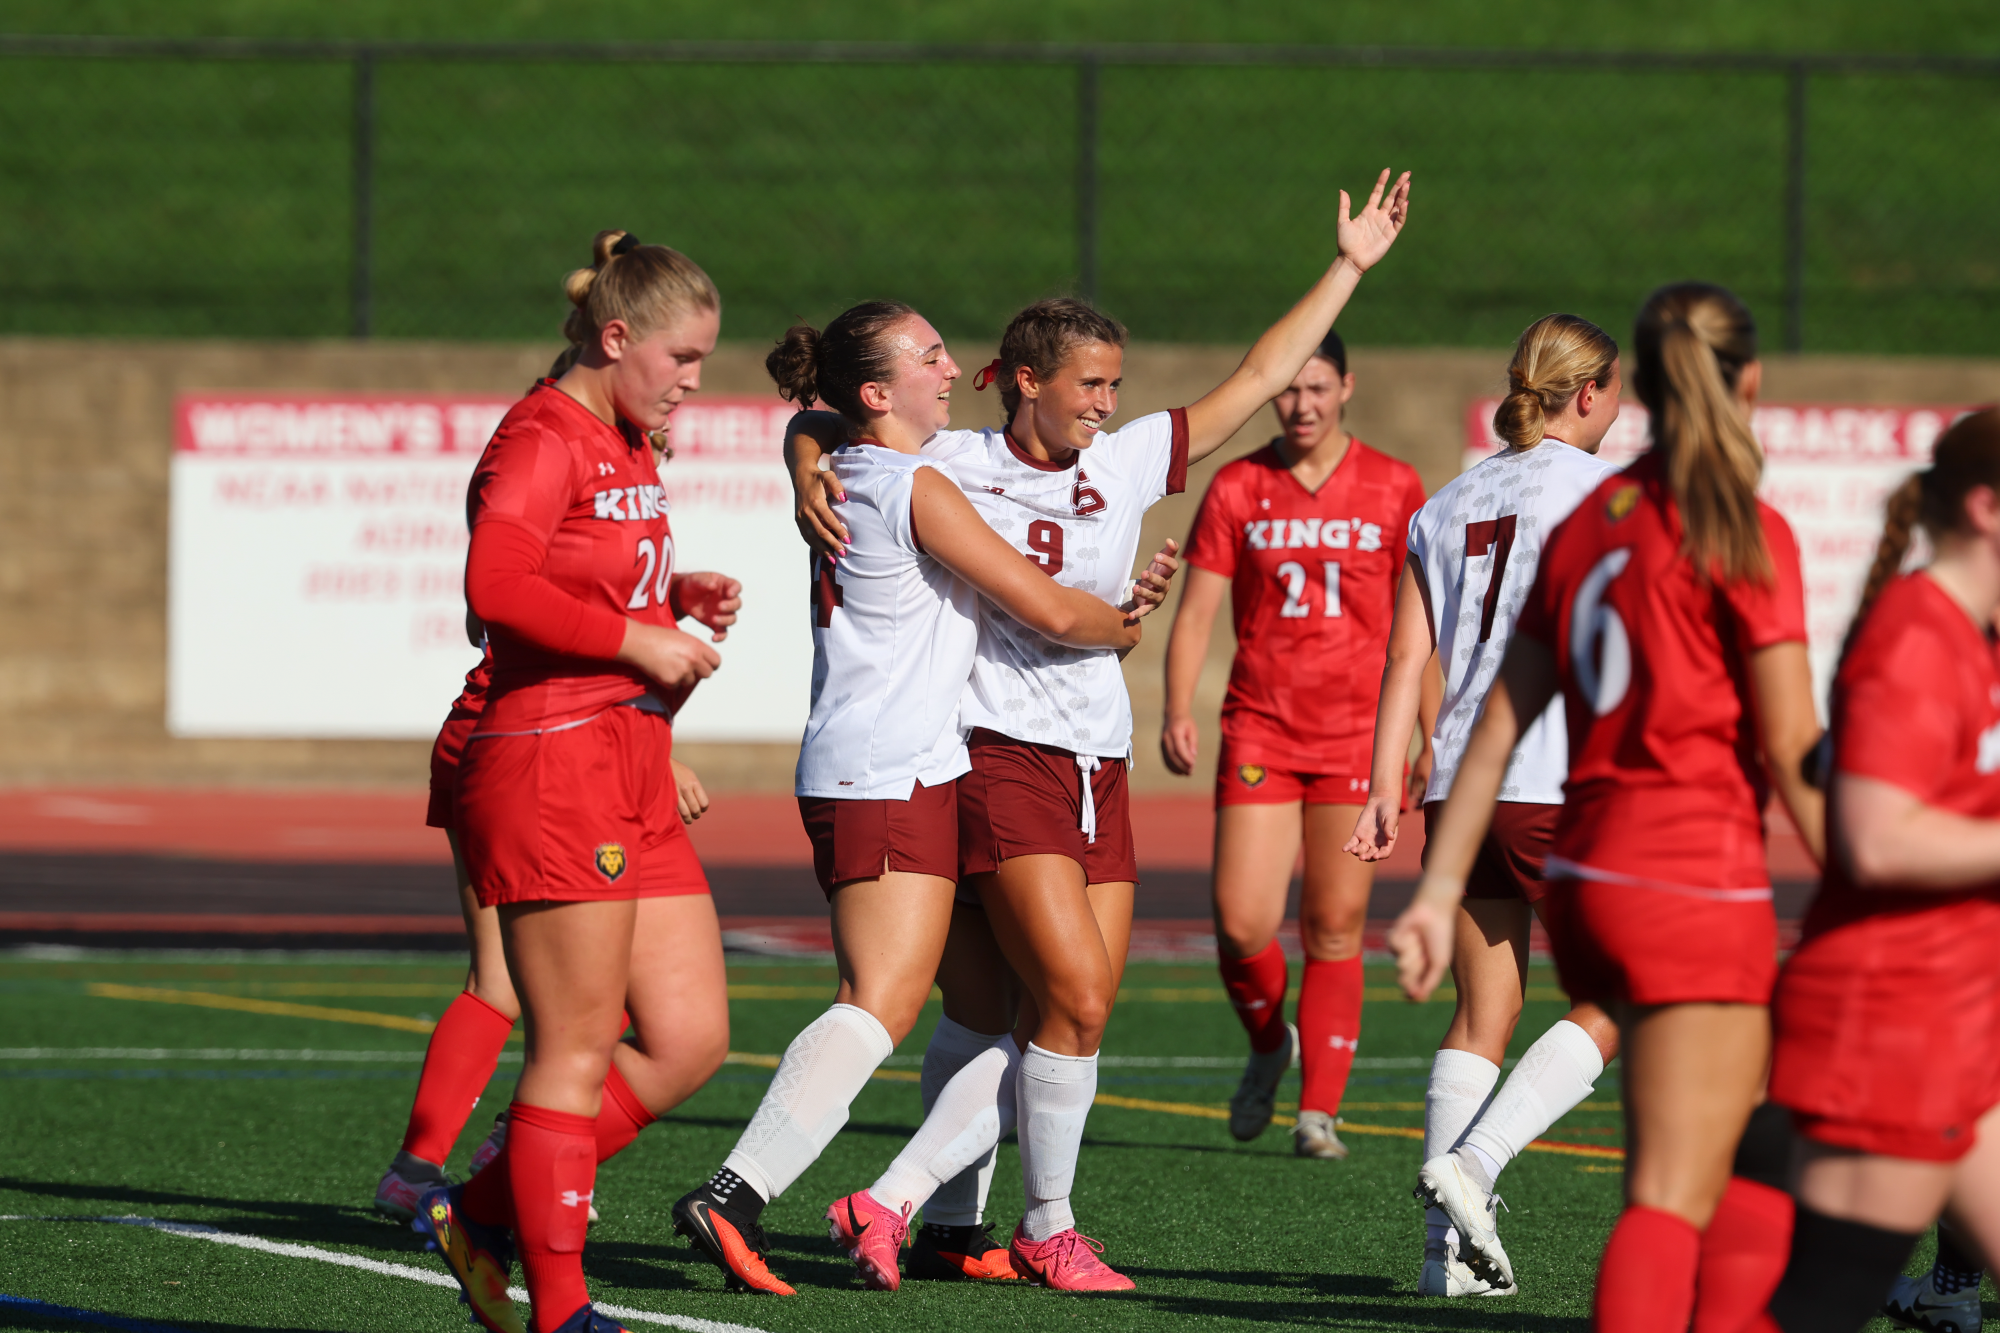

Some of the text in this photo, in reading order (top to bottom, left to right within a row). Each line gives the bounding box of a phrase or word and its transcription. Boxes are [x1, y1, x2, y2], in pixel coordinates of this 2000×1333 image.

[187, 403, 442, 453] WOMEN'S
[592, 481, 671, 521] KING
[1026, 519, 1063, 577] 9
[1244, 517, 1382, 552] KING'S
[628, 531, 675, 610] 20
[1276, 560, 1343, 618] 21
[1466, 514, 1517, 643] 7
[1570, 547, 1632, 717] 6
